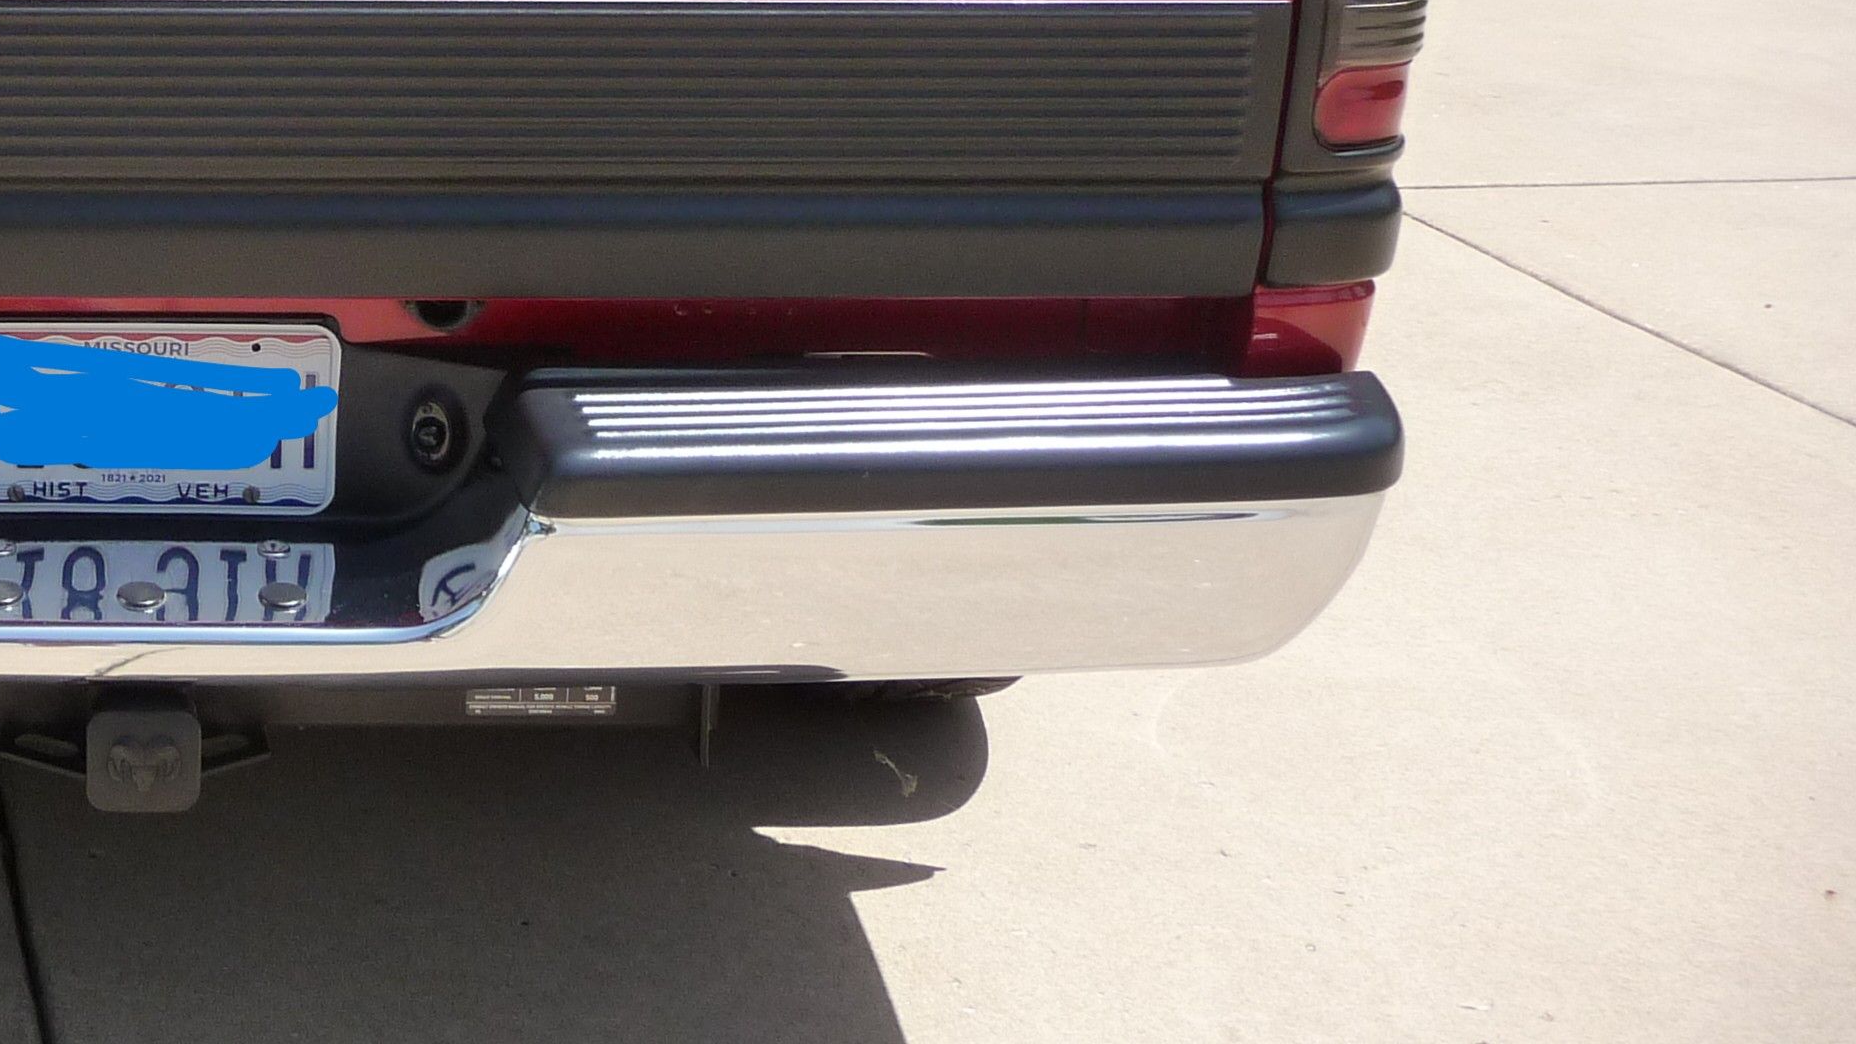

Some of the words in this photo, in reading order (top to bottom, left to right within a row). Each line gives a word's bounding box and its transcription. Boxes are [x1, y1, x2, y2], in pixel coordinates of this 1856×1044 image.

[101, 473, 127, 483] 1821
[139, 473, 166, 484] 2021
[33, 481, 88, 497] HIST
[177, 483, 229, 499] VEH
